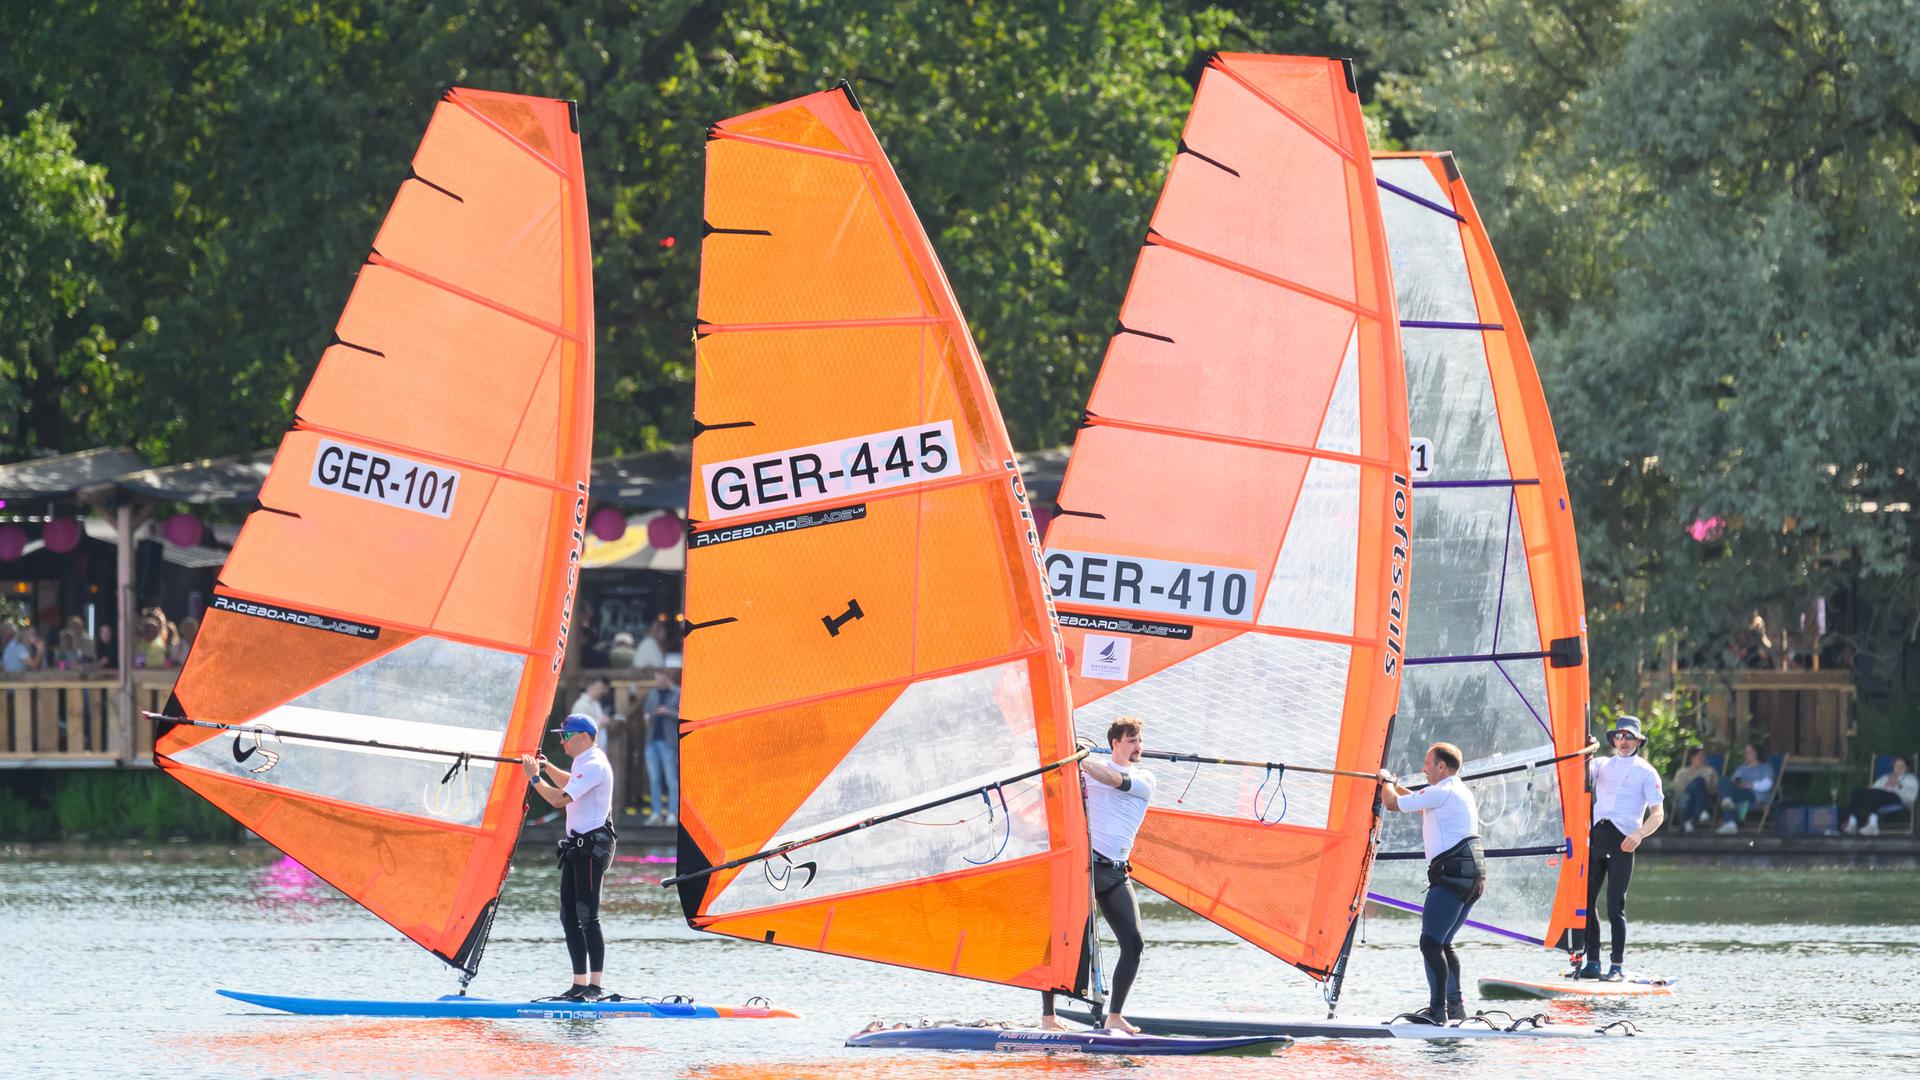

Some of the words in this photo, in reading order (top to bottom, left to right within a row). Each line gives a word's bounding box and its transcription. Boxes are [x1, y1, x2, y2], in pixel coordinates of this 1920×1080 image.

[318, 446, 455, 513] GER-101
[711, 430, 948, 511] GER-445
[1411, 444, 1428, 471] 1
[1045, 553, 1247, 616] GER-410
[1384, 472, 1409, 679] loftsails
